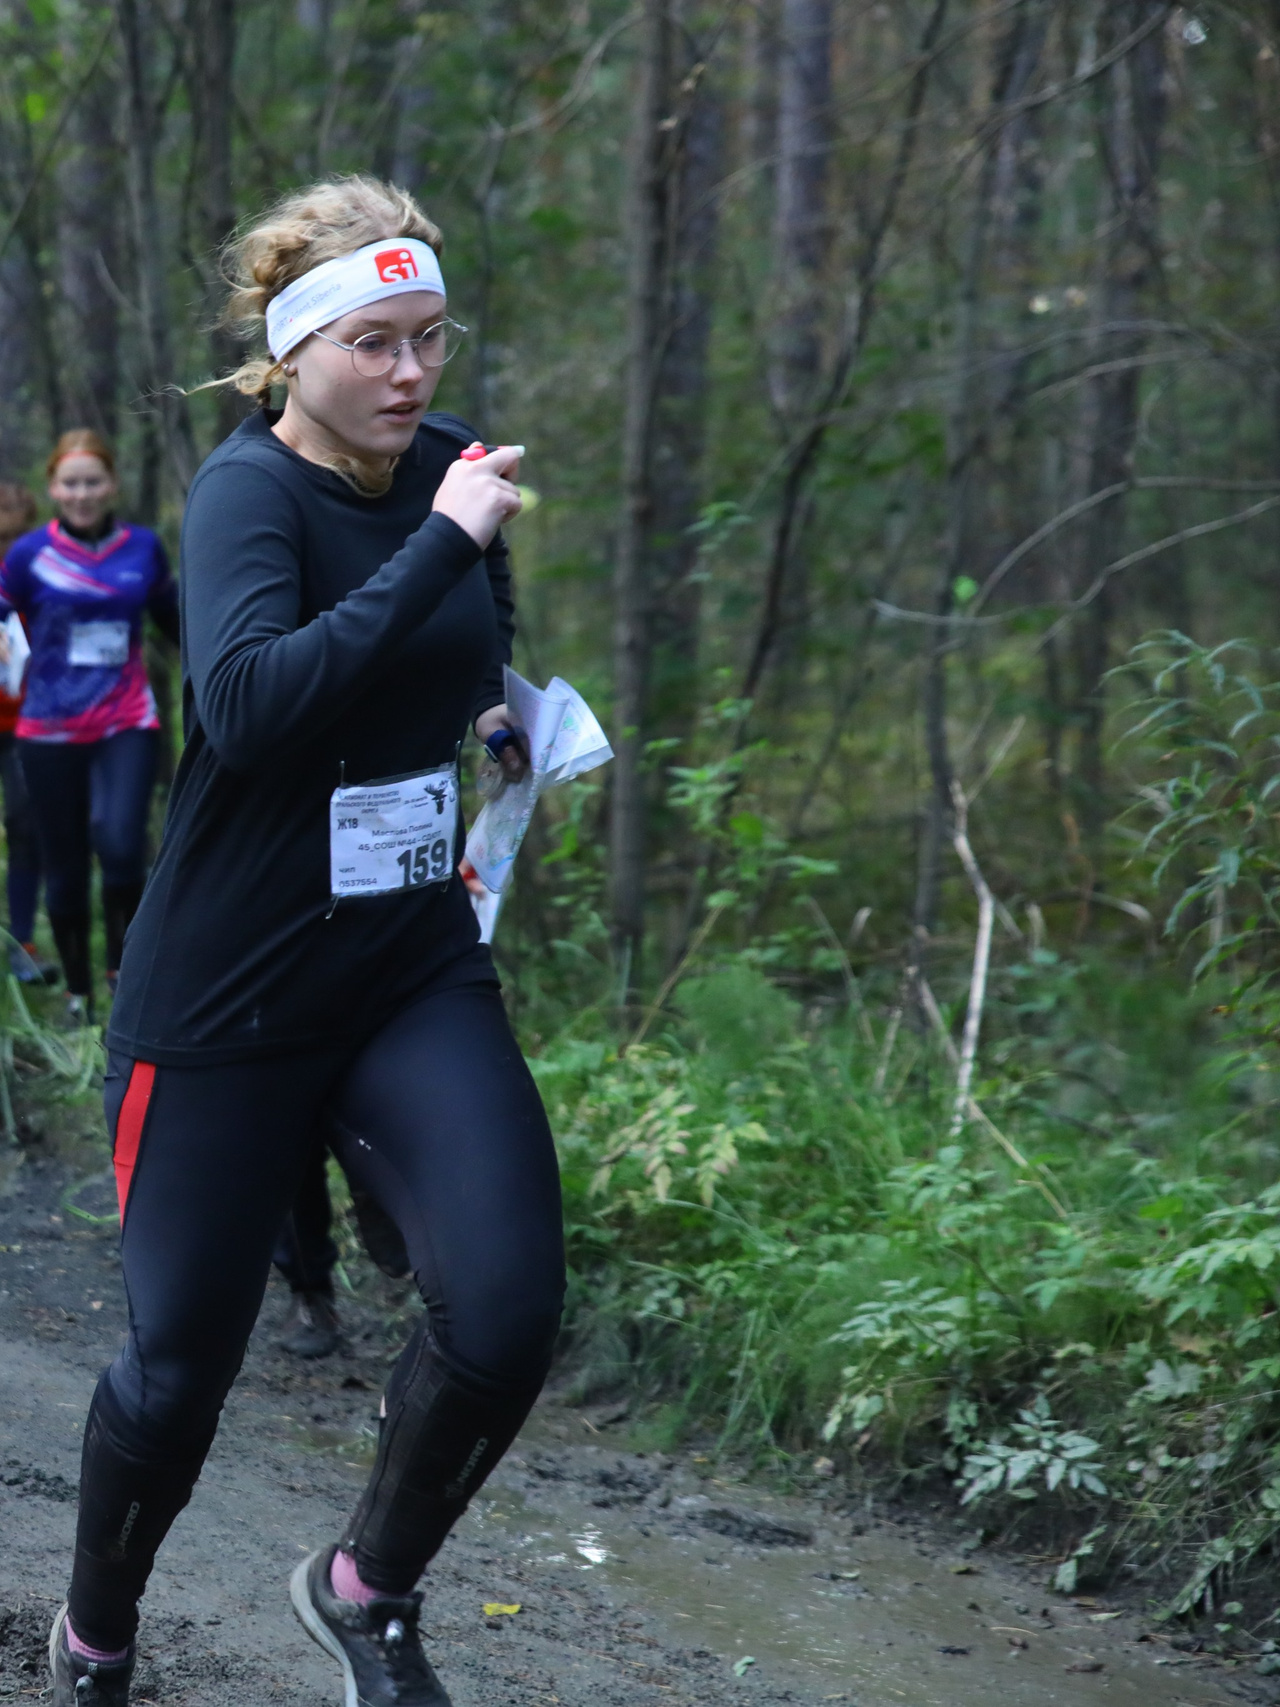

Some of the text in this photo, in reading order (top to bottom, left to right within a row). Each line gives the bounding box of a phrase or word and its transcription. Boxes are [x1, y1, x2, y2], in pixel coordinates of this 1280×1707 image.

[337, 817, 359, 830] Ж18
[397, 839, 447, 888] 159
[456, 1437, 489, 1483] NORD
